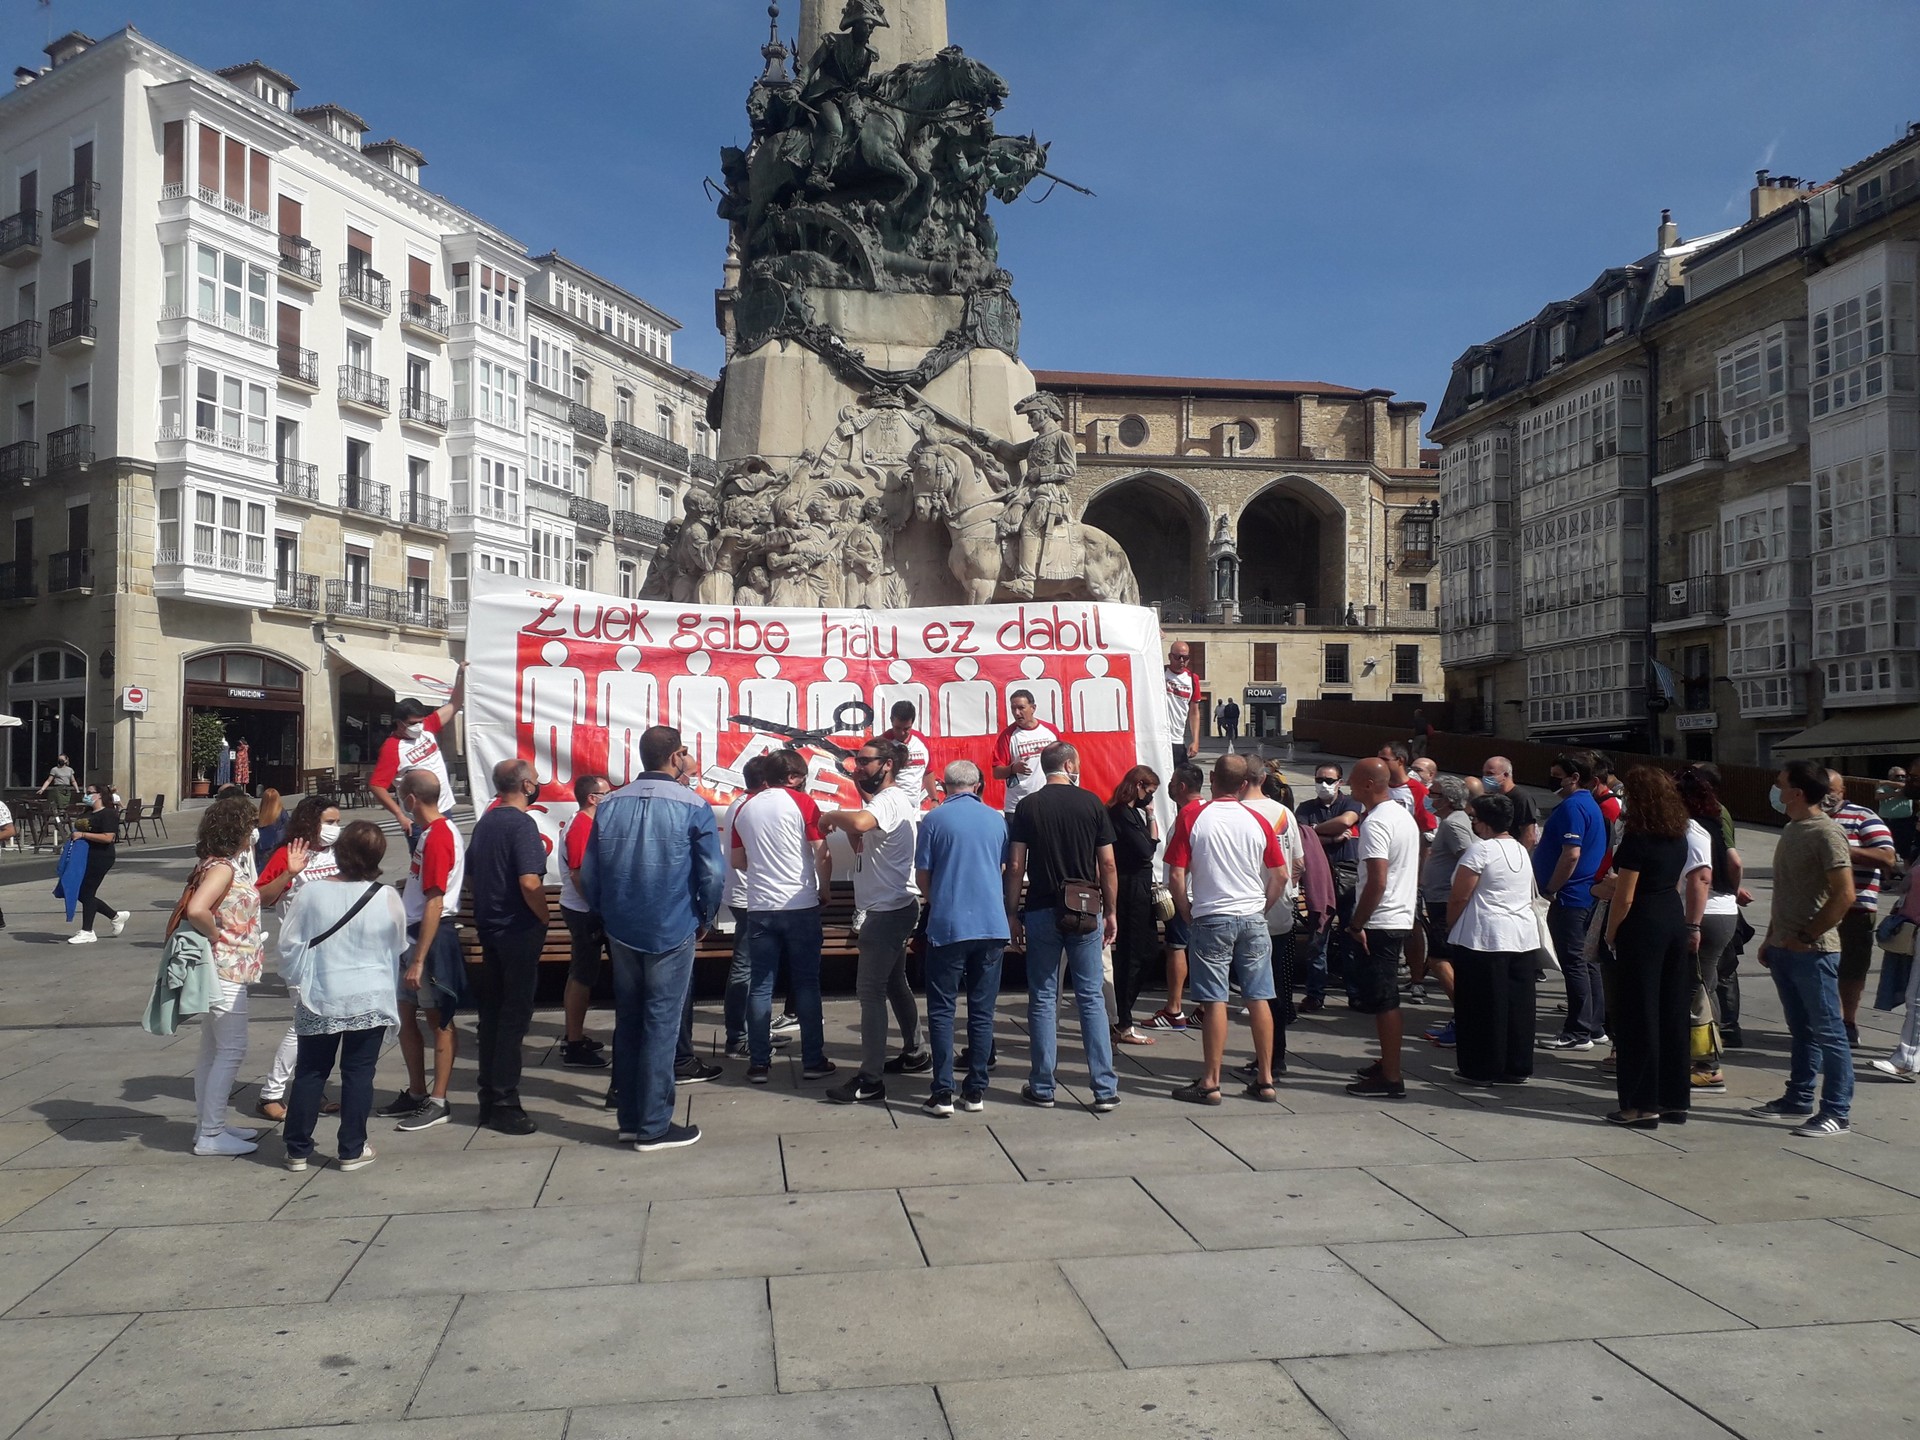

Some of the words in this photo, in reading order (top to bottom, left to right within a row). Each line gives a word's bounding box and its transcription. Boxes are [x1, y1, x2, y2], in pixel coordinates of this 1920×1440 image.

[522, 589, 654, 643] Zuek
[669, 608, 790, 653] gabe
[821, 611, 899, 660] hau
[922, 621, 980, 653] ez
[996, 604, 1109, 650] dabil
[1247, 689, 1273, 697] ROMA
